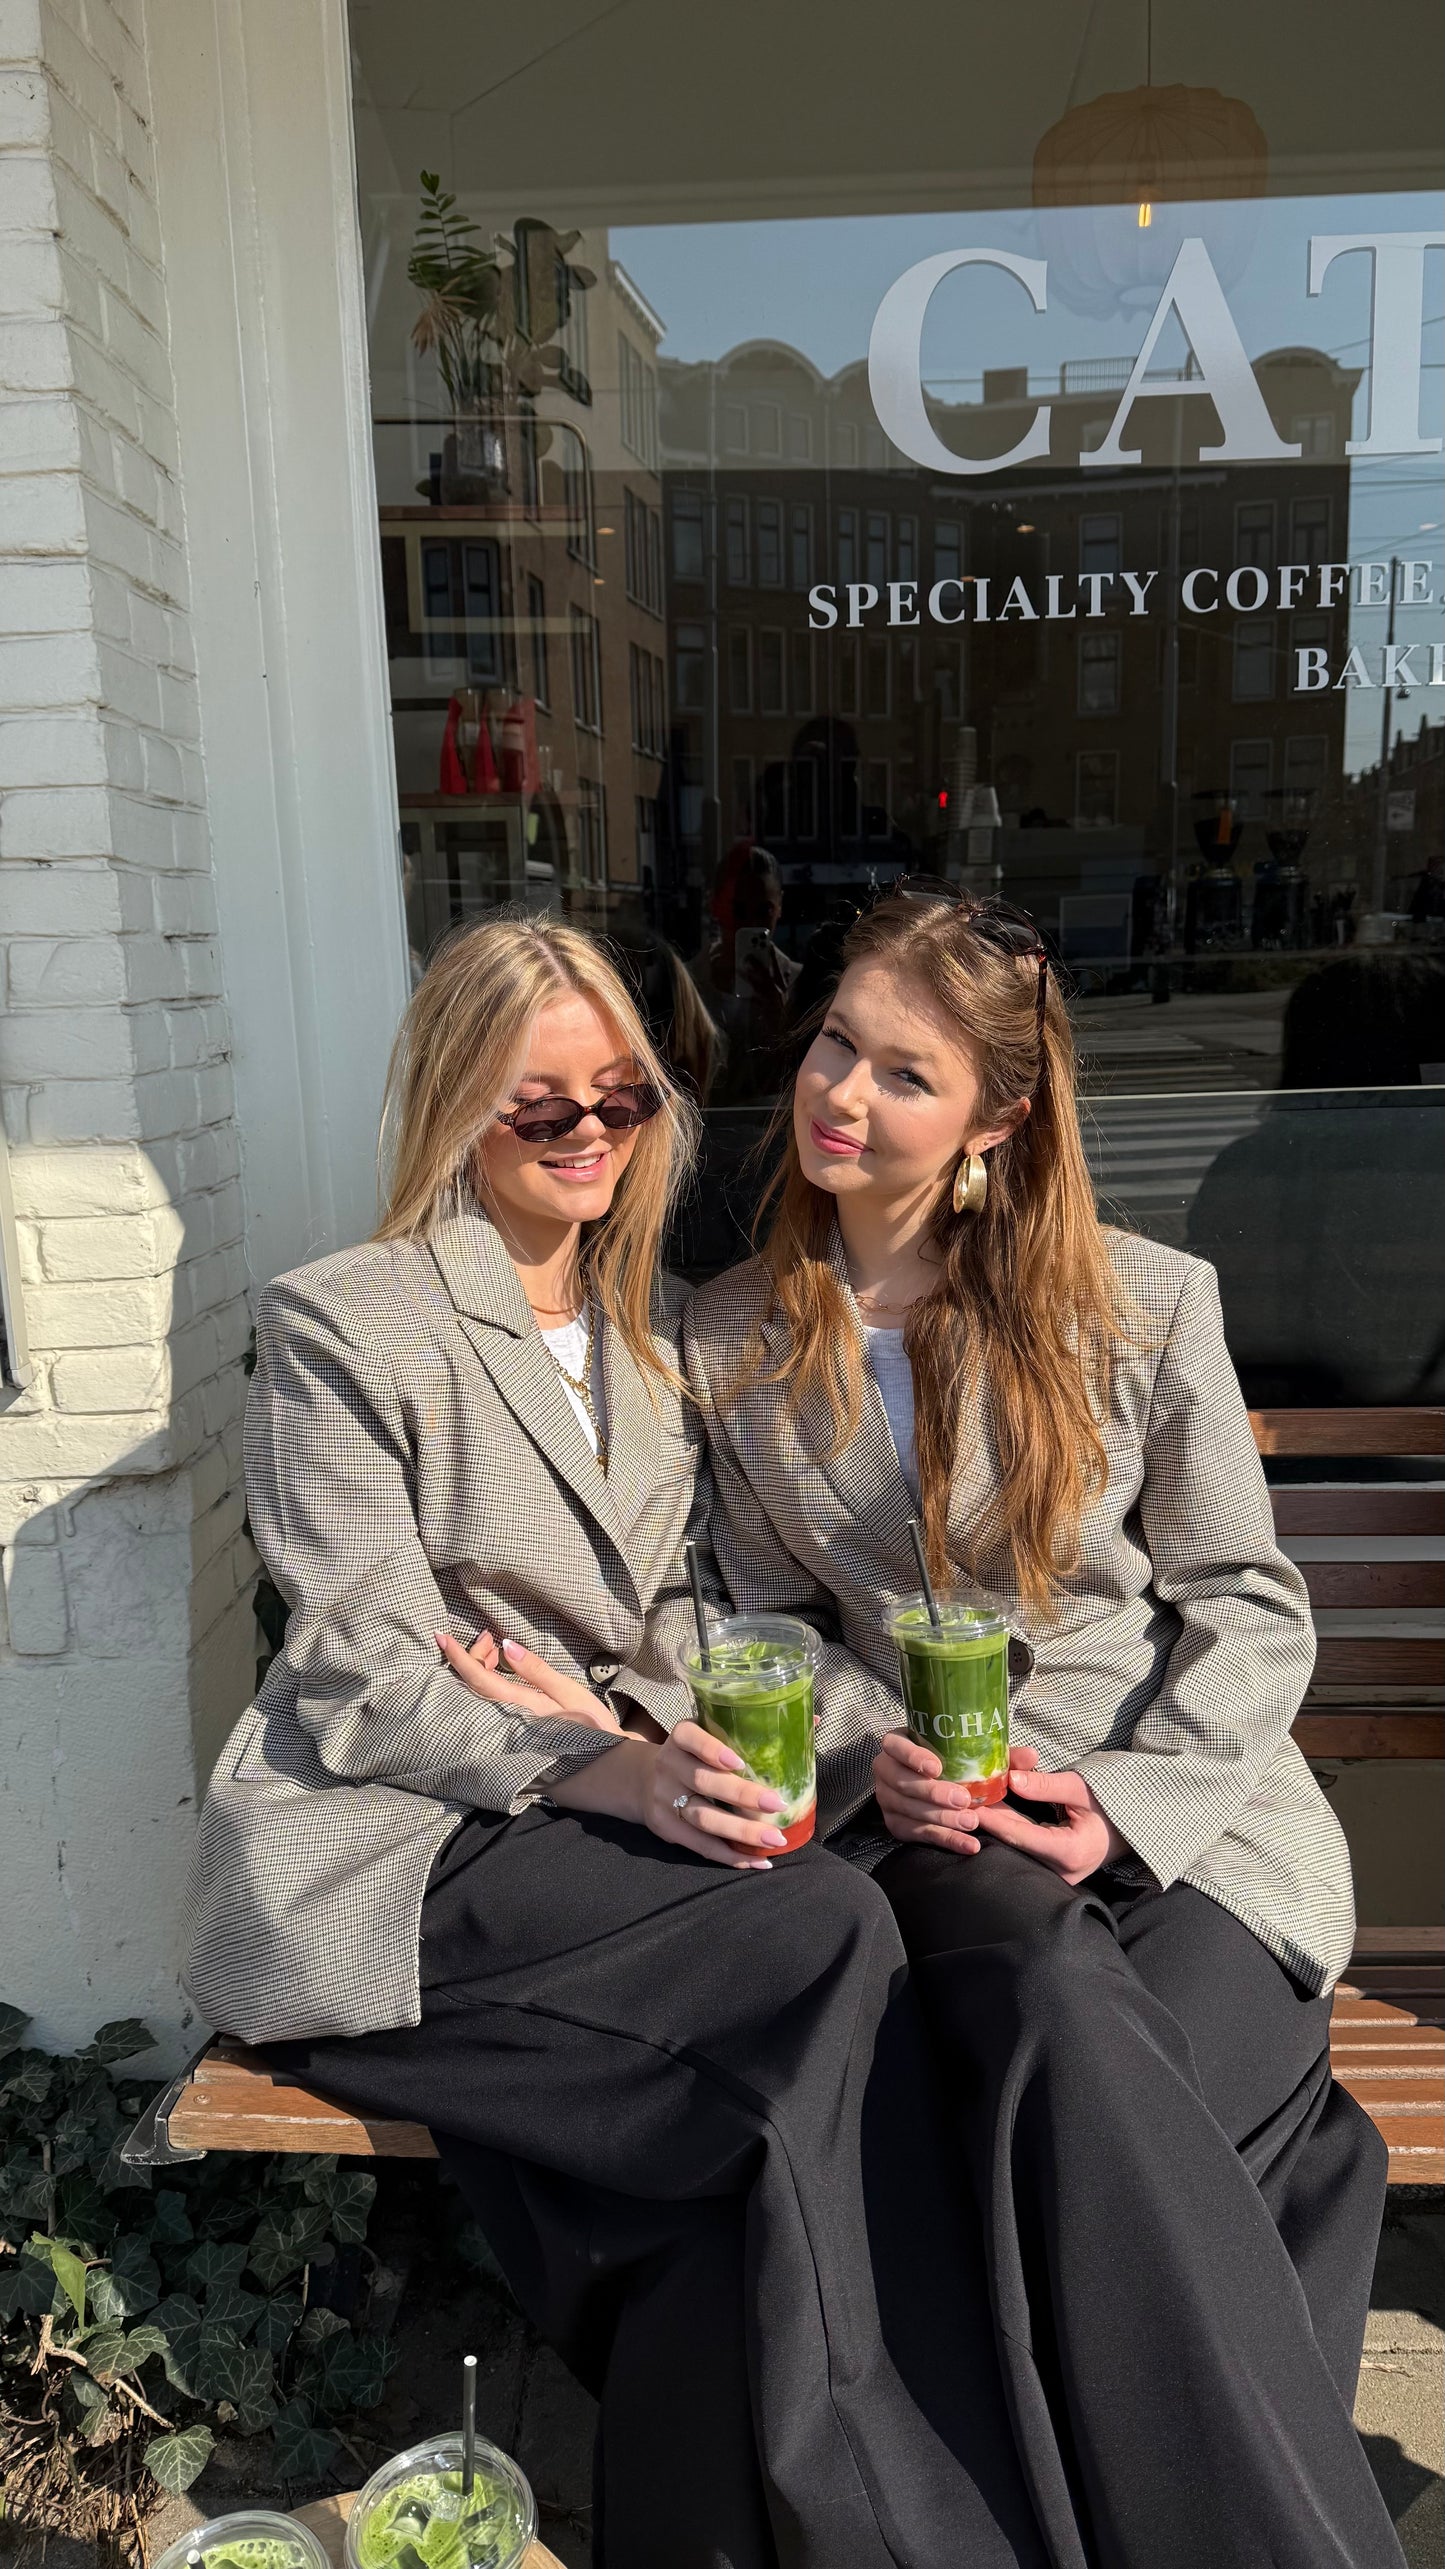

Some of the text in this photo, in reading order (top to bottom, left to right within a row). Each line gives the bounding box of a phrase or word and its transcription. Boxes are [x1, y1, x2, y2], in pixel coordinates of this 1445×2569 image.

[867, 231, 1445, 475] CAT
[808, 560, 1445, 629] SPECIALTY COFFEE
[911, 1707, 1005, 1739] TCHA
